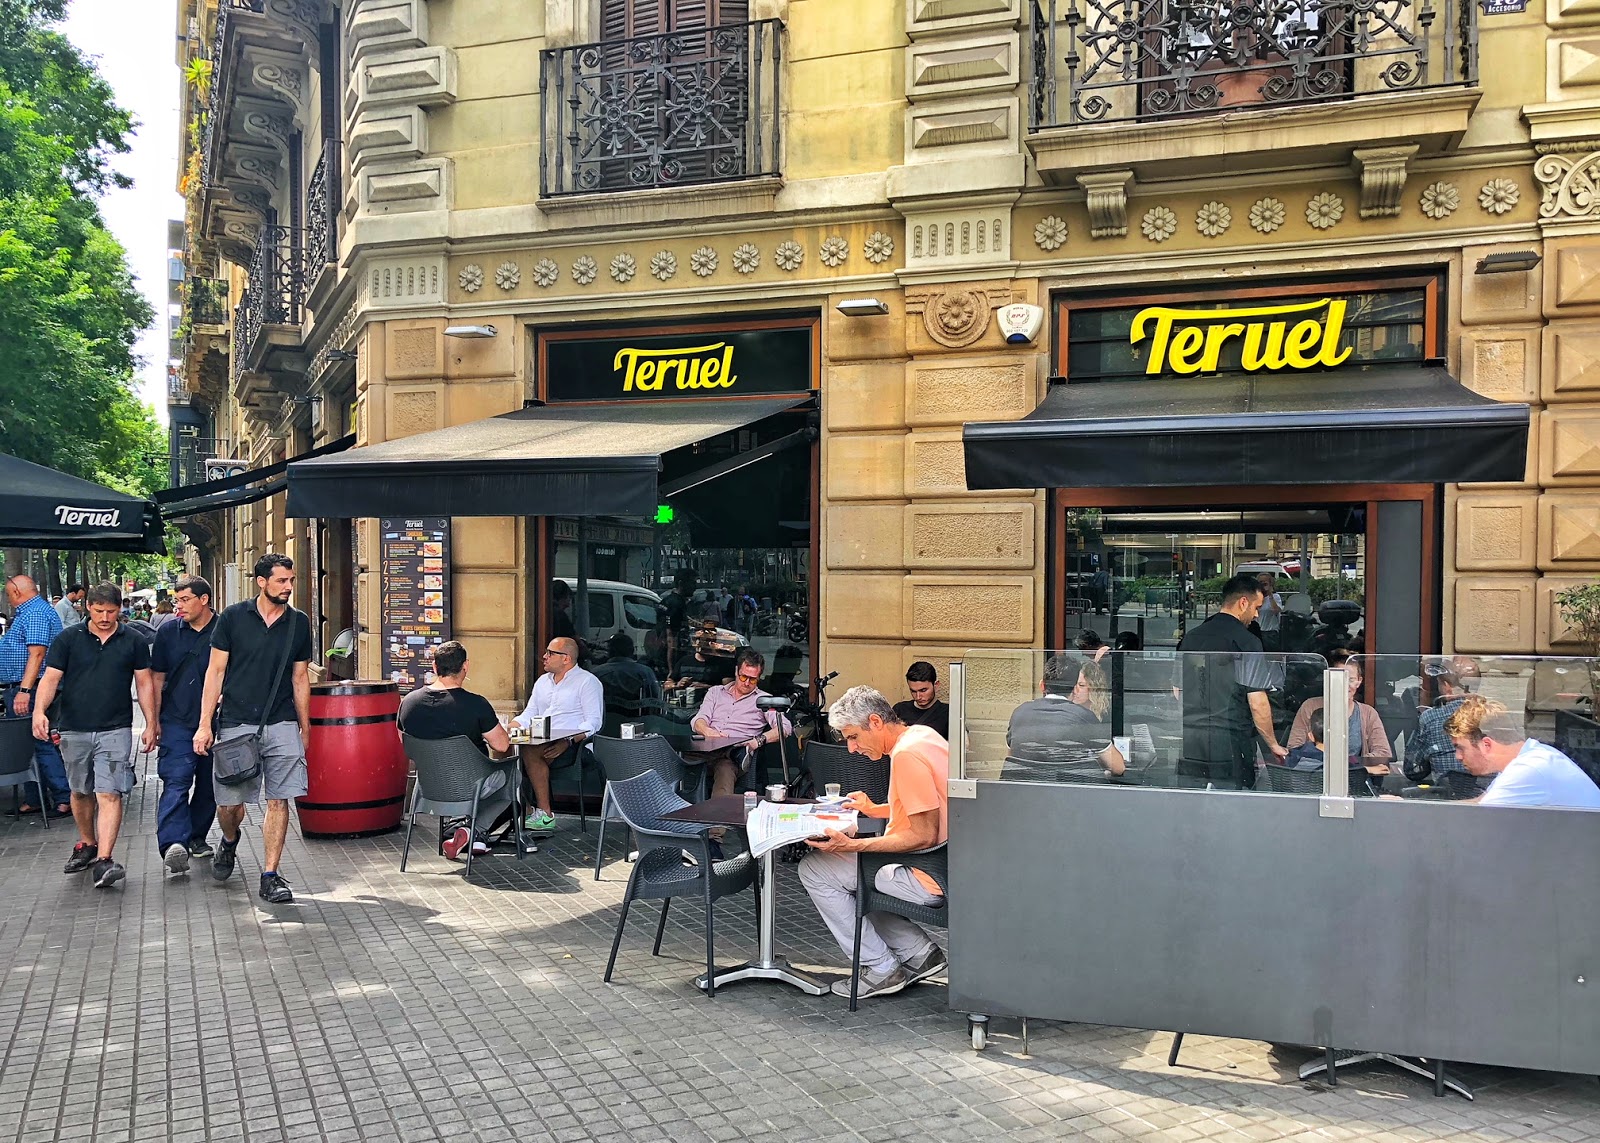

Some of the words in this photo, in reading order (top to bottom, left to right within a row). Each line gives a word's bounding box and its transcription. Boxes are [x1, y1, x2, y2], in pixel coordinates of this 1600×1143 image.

[1488, 4, 1521, 13] ACCESORIO
[1130, 298, 1353, 375] Teruel
[614, 342, 737, 391] Teruel
[55, 506, 120, 527] Teruel
[405, 520, 424, 528] Teruel
[383, 560, 389, 575] 2
[384, 576, 389, 592] 3
[383, 593, 389, 608] 4
[383, 609, 390, 625] 5
